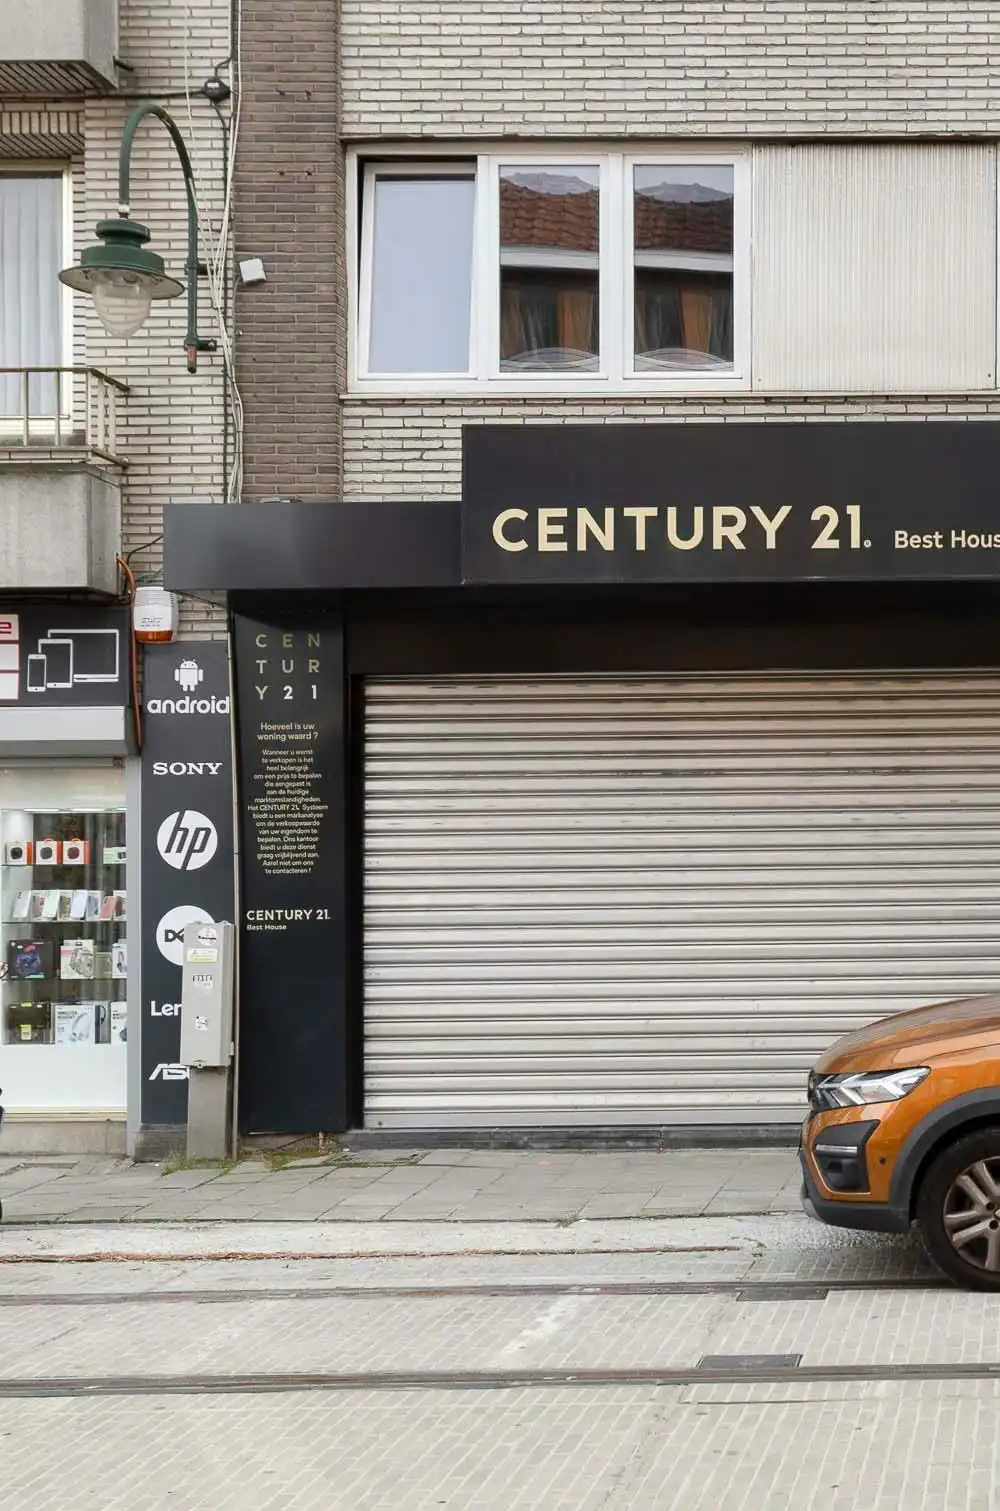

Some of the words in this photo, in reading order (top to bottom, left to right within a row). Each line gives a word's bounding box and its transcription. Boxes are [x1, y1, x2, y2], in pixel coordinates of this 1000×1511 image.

[492, 505, 792, 552] CENTURY
[894, 530, 945, 549] Best
[147, 695, 230, 715] android
[260, 722, 293, 731] Hoeveel
[295, 722, 301, 730] is
[303, 722, 315, 730] uw
[256, 733, 286, 742] woning
[288, 732, 312, 740] waard
[153, 762, 222, 776] SONY
[259, 804, 290, 812] CENTURY
[164, 810, 210, 870] hp
[246, 909, 312, 922] CENTURY
[246, 924, 261, 932] Best
[264, 923, 287, 932] House
